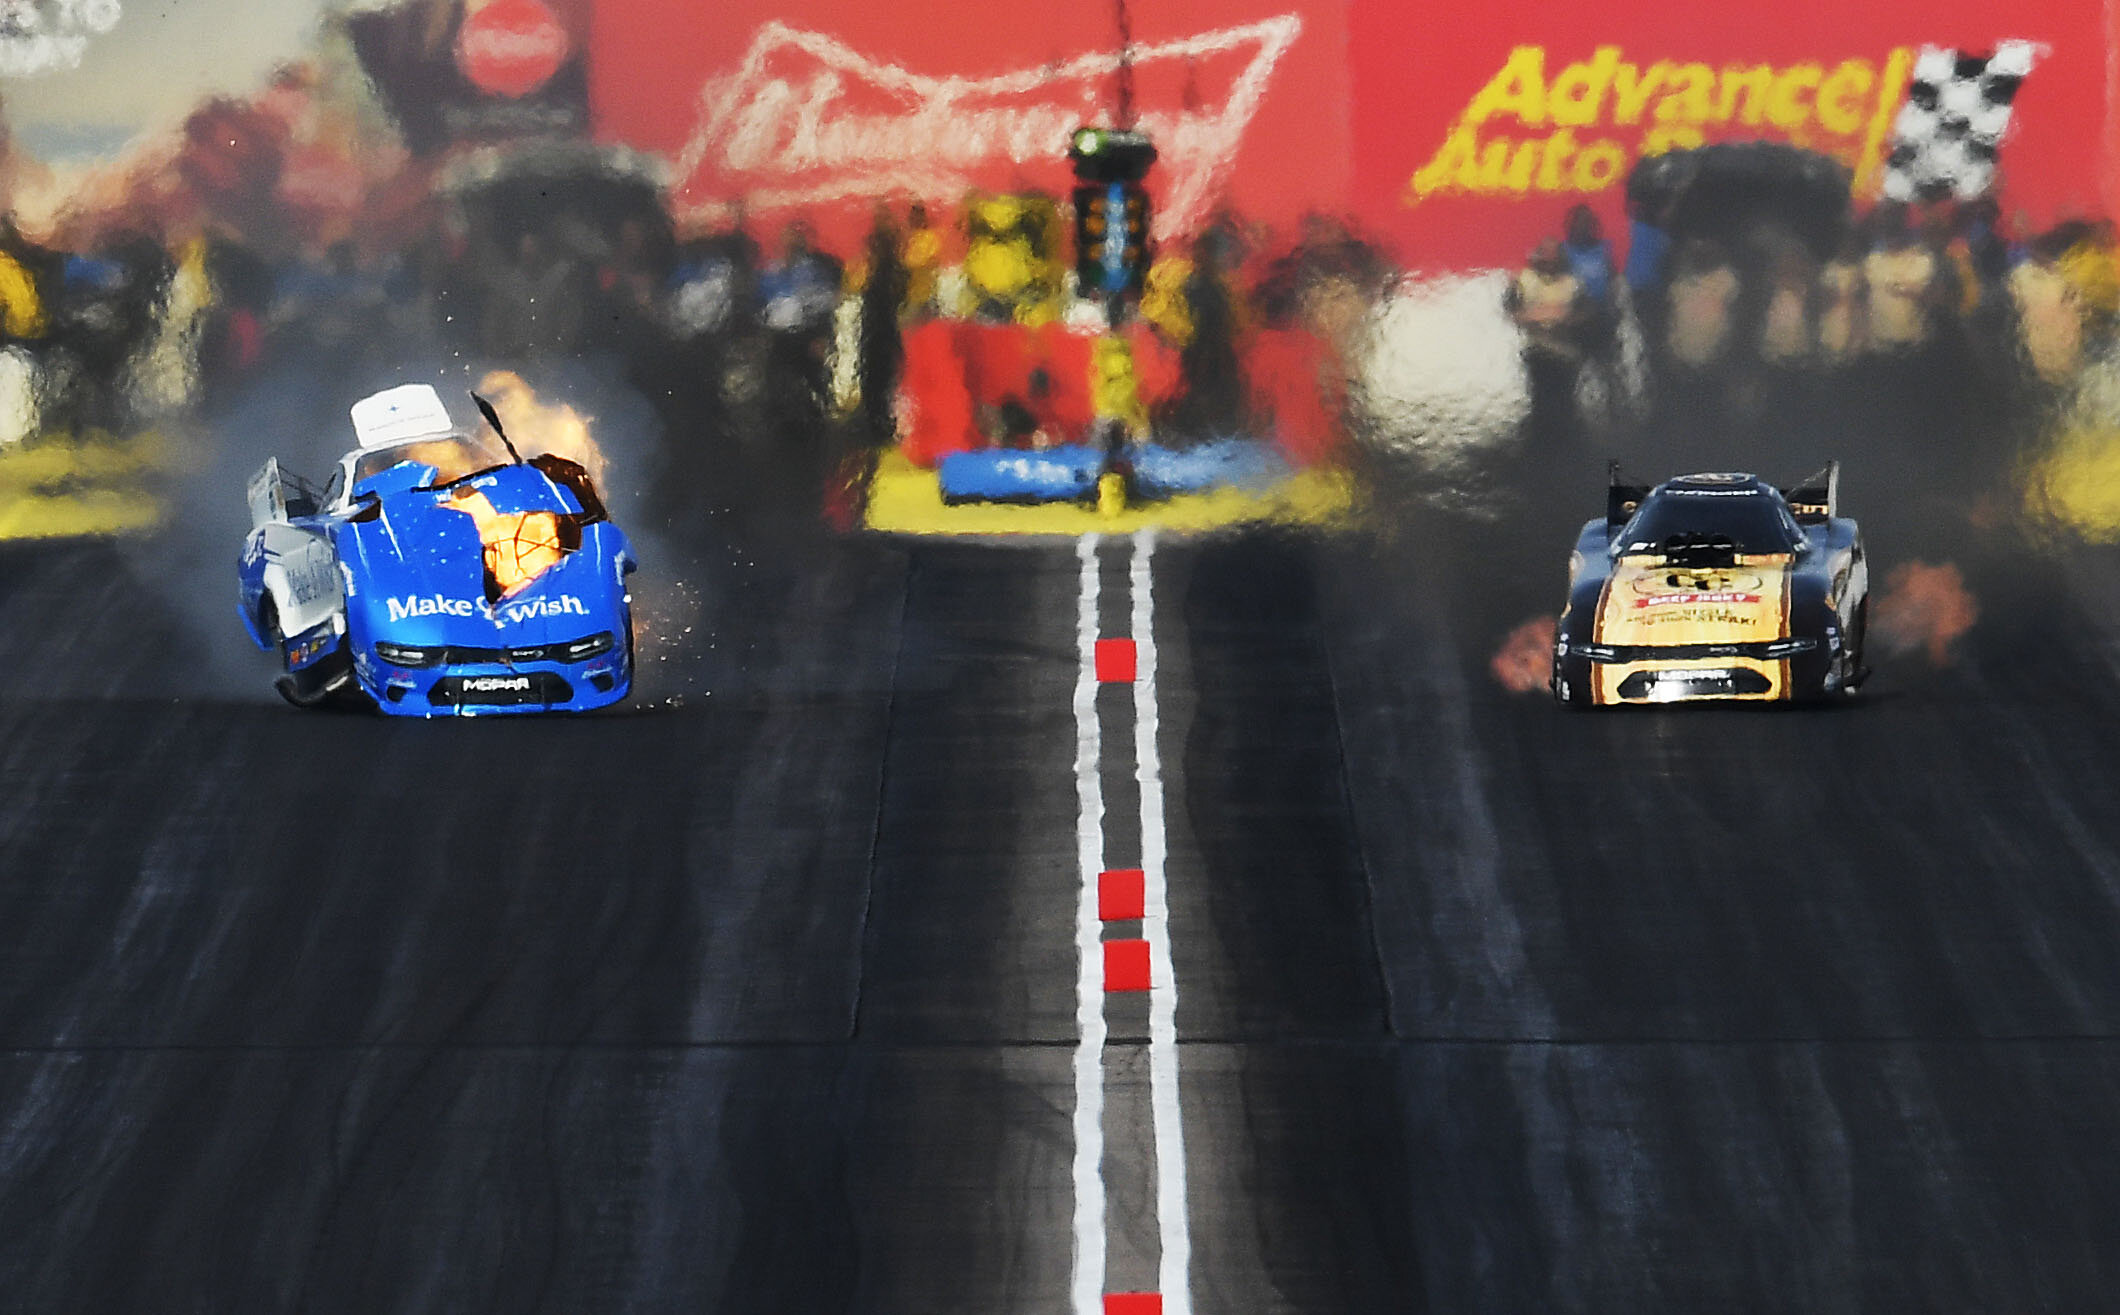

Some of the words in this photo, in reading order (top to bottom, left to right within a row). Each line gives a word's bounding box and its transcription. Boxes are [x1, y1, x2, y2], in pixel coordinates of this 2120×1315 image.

[1466, 45, 1876, 134] Advance
[1411, 127, 1626, 194] Auto
[386, 594, 473, 622] Make
[463, 677, 530, 692] MOPAR
